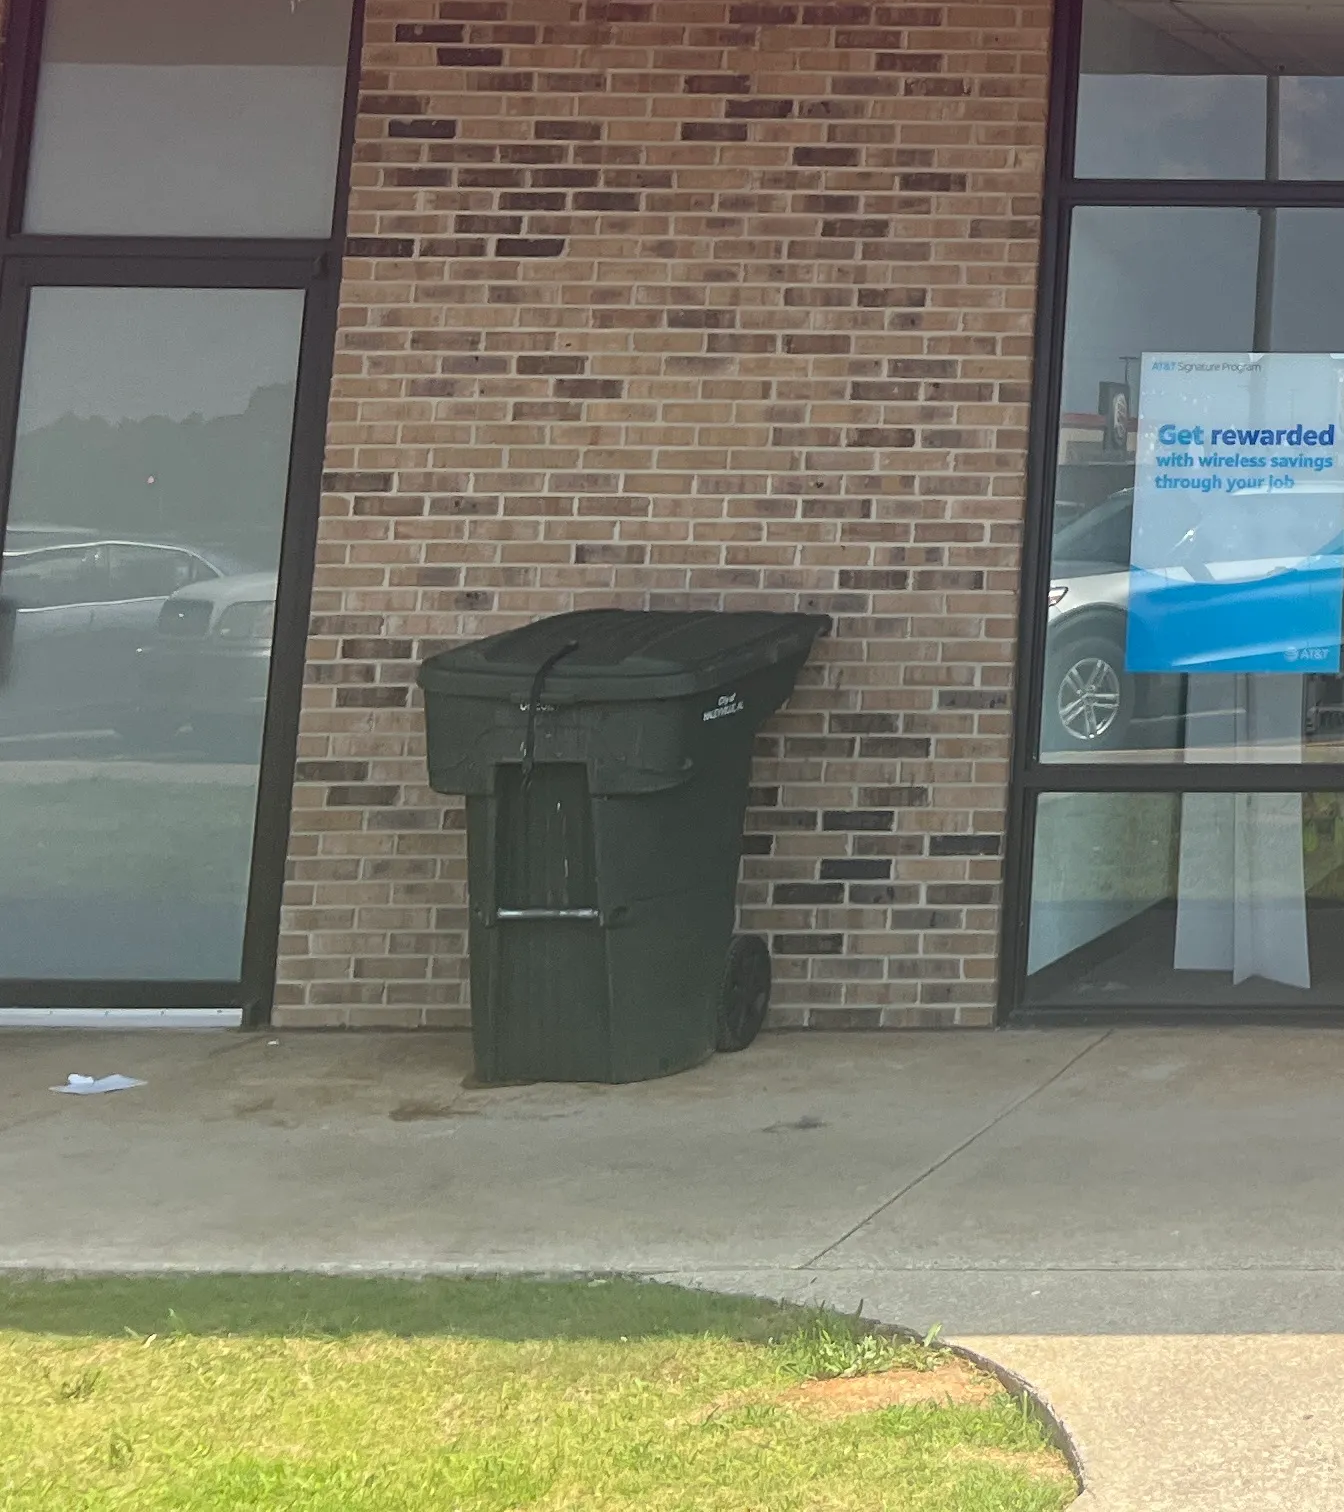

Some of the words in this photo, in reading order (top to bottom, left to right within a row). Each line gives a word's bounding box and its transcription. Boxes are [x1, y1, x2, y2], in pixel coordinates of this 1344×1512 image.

[1178, 362, 1221, 373] Signature
[1222, 362, 1262, 373] Program
[1158, 424, 1204, 447] Get
[1211, 423, 1335, 446] rewarded
[1156, 453, 1194, 468] with
[1198, 453, 1266, 469] wireless
[1270, 454, 1333, 471] savings
[1155, 475, 1222, 492] through
[1226, 477, 1265, 493] your
[1266, 476, 1295, 493] job
[1300, 648, 1330, 660] AT&T
